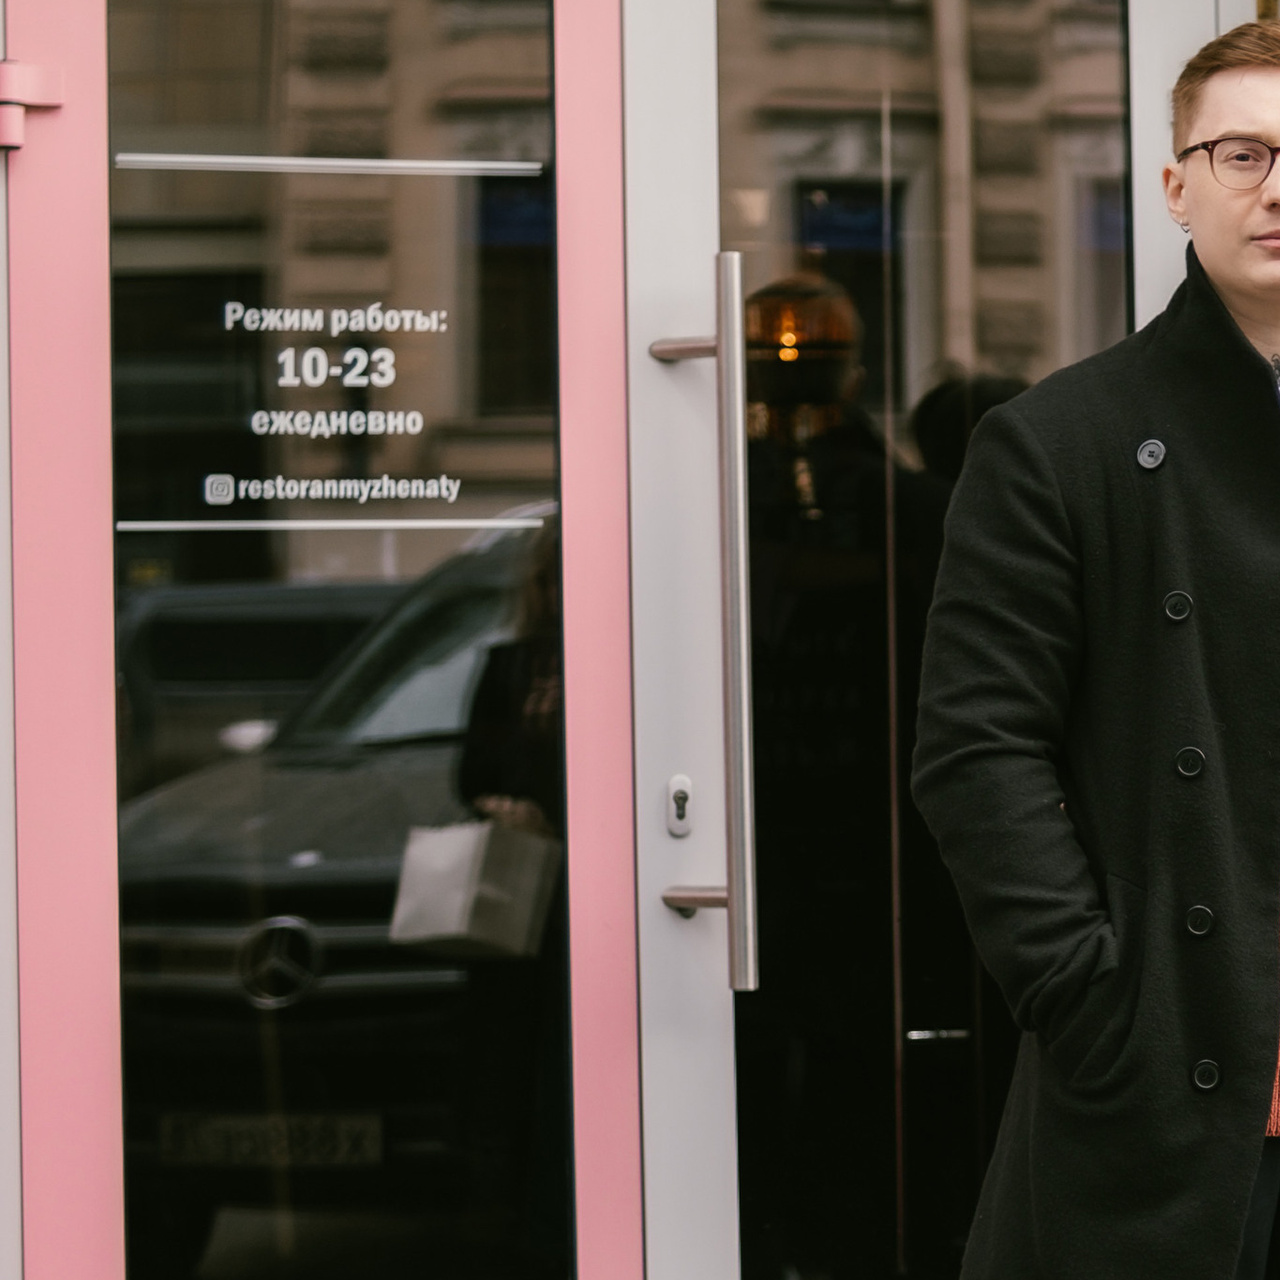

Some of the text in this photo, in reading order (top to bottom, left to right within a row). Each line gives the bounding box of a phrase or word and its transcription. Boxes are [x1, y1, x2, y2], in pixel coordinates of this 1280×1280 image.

[225, 301, 448, 337] Режим работы:
[277, 347, 397, 388] 10-23
[251, 410, 423, 438] ежедневно
[238, 474, 460, 503] restoranmyzhenaty
